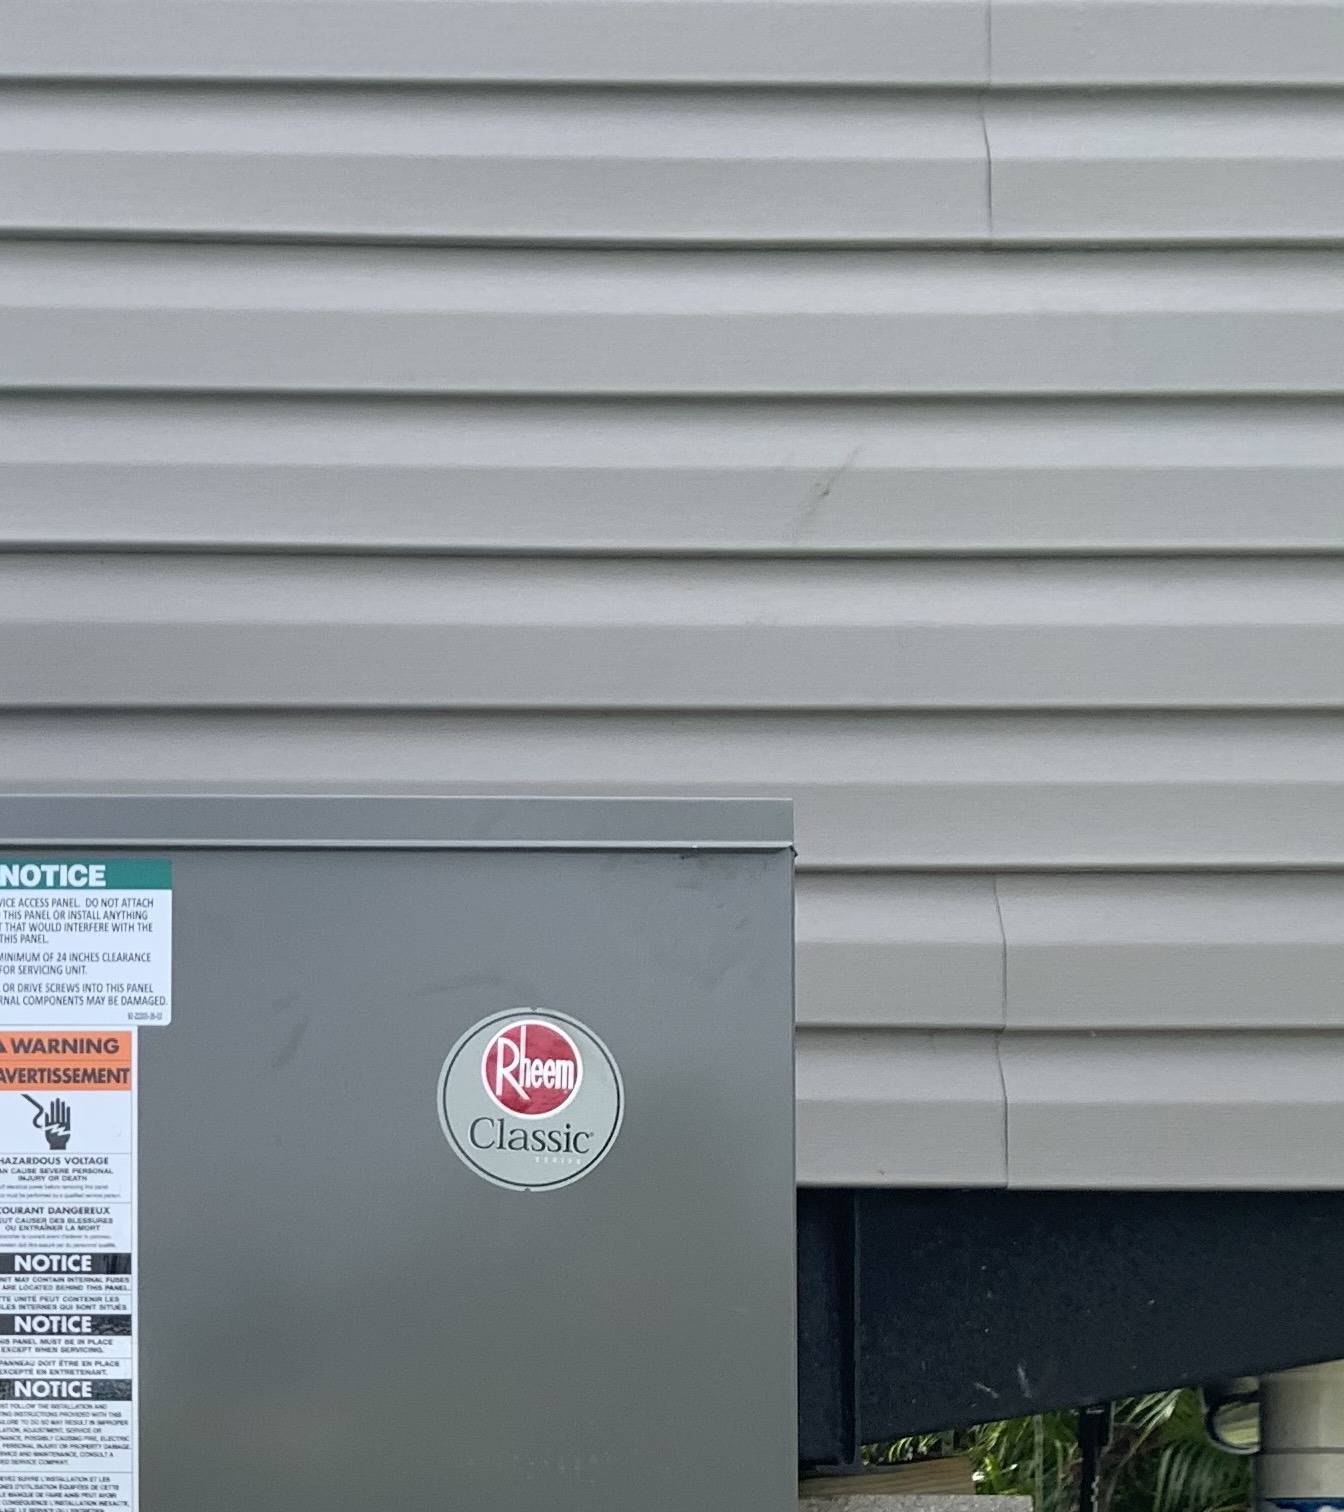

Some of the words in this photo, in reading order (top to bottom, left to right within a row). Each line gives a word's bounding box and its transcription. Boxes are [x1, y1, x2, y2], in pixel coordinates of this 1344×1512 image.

[0, 864, 106, 887] NOTICE
[18, 898, 49, 908] ACCESS
[51, 898, 80, 908] PANEL.
[84, 898, 98, 908] DO
[100, 898, 118, 908] NOT
[121, 898, 153, 908] ATTACH
[3, 911, 22, 920] THIS
[23, 911, 50, 920] PANEL
[52, 911, 65, 920] OR
[67, 911, 100, 920] INSTALL
[102, 911, 148, 920] ANYTHING
[5, 922, 25, 932] THAT
[28, 922, 61, 932] WOULD
[63, 922, 108, 932] INTERFERE
[111, 922, 134, 932] WITH
[137, 922, 153, 932] THE
[0, 934, 17, 944] THIS
[19, 934, 48, 944] PANEL.
[42, 953, 53, 962] OF
[56, 953, 66, 962] 24
[68, 953, 99, 962] INCHES
[101, 953, 151, 962] CLEARANCE
[17, 965, 63, 975] SERVICING
[64, 965, 87, 975] UNIT.
[2, 983, 15, 992] OR
[17, 983, 42, 993] DRIVE
[45, 983, 80, 993] SCREWS
[82, 983, 103, 993] INTO
[106, 983, 124, 993] THIS
[126, 983, 153, 993] PANEL
[22, 996, 84, 1006] COMPONENTS
[86, 996, 105, 1006] MAY
[107, 996, 118, 1006] BE
[120, 996, 168, 1006] DAMAGED.
[11, 1038, 119, 1054] WARNING
[495, 1026, 575, 1100] Rheem
[64, 1157, 108, 1166] VOLTAGE
[47, 1206, 110, 1215] DANGEREUX
[14, 1255, 91, 1272] NOTICE
[14, 1316, 91, 1333] NOTICE
[14, 1381, 92, 1398] NOTICE
